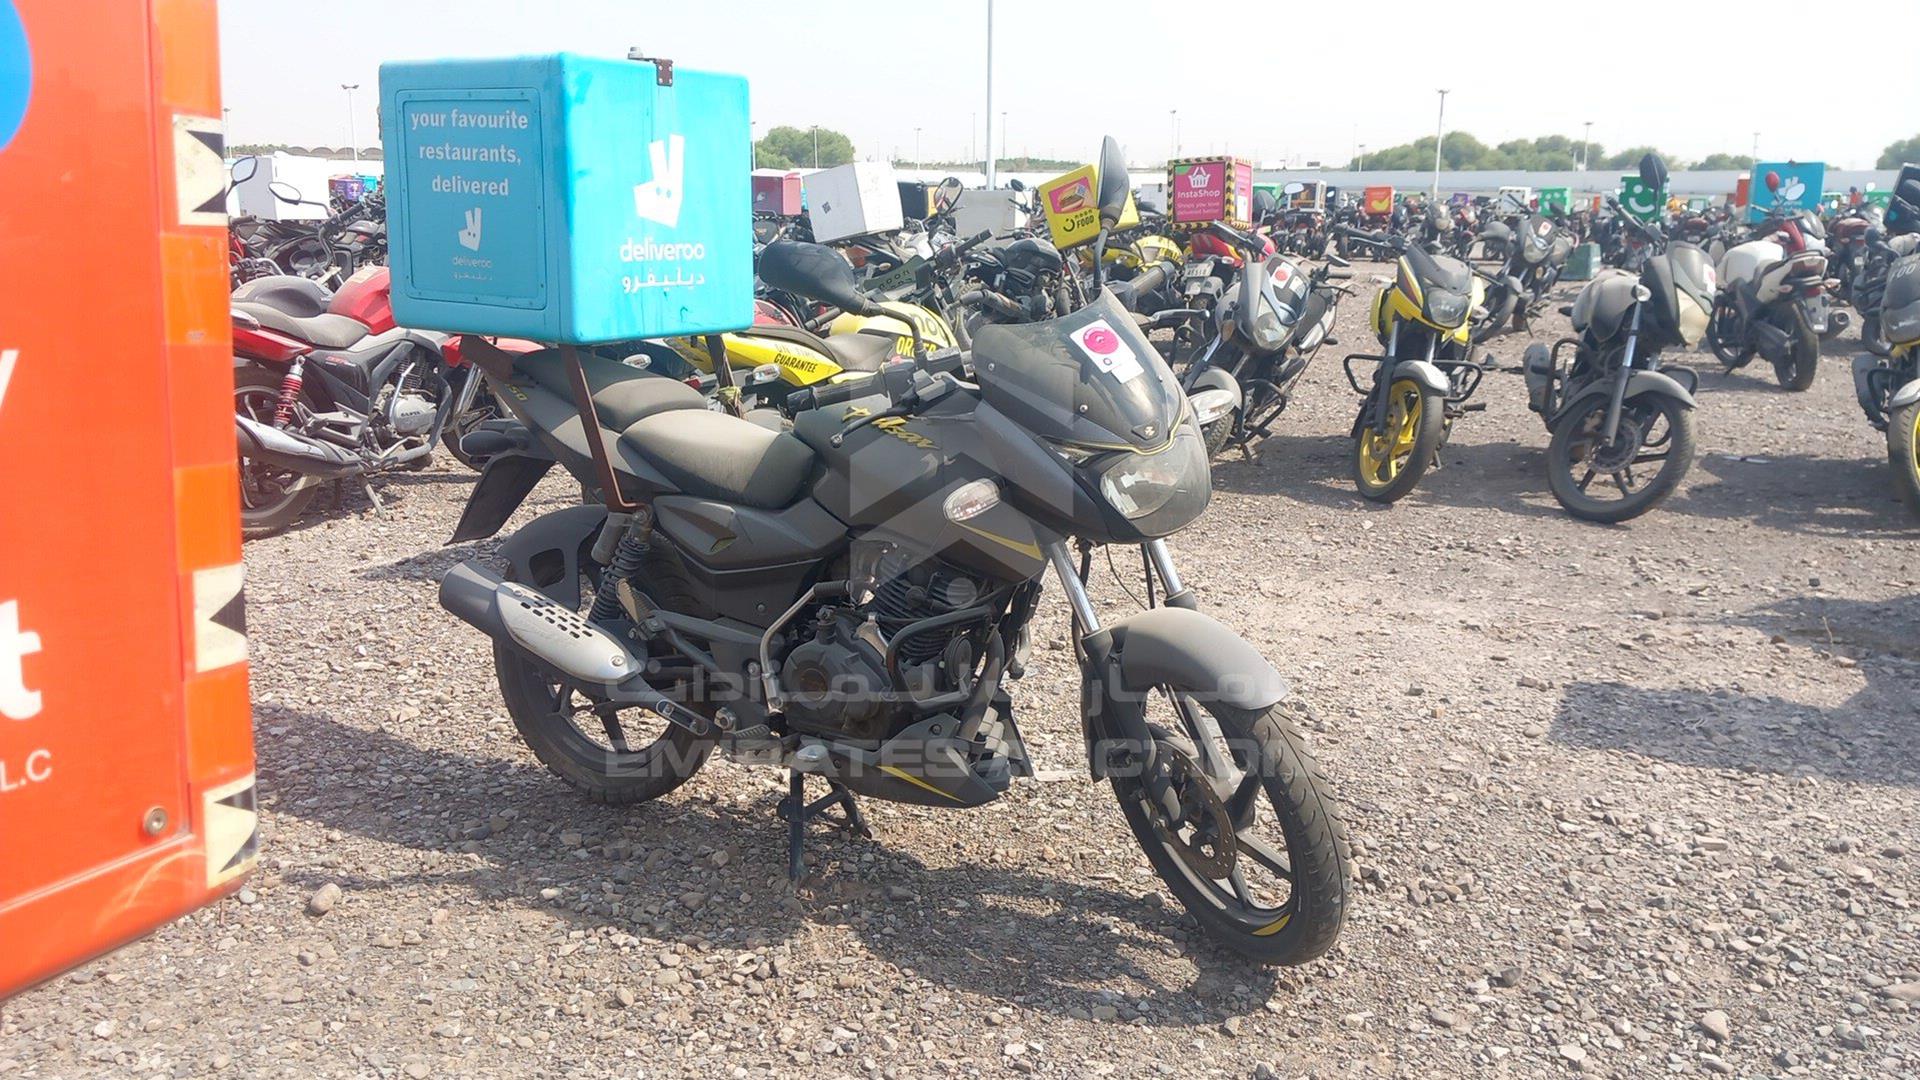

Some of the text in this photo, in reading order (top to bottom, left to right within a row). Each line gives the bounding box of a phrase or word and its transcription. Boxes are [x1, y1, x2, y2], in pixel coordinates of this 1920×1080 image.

[410, 108, 528, 130] your favourite
[419, 143, 521, 165] restaurants,
[431, 174, 509, 196] delivered
[1177, 189, 1221, 199] InstaShop
[1076, 214, 1095, 229] FOOD
[619, 236, 706, 262] deliveroo
[452, 256, 492, 268] deliveroo
[621, 265, 706, 294] ديليفرو
[896, 336, 937, 358] ORR
[773, 353, 819, 374] GUARANTEE
